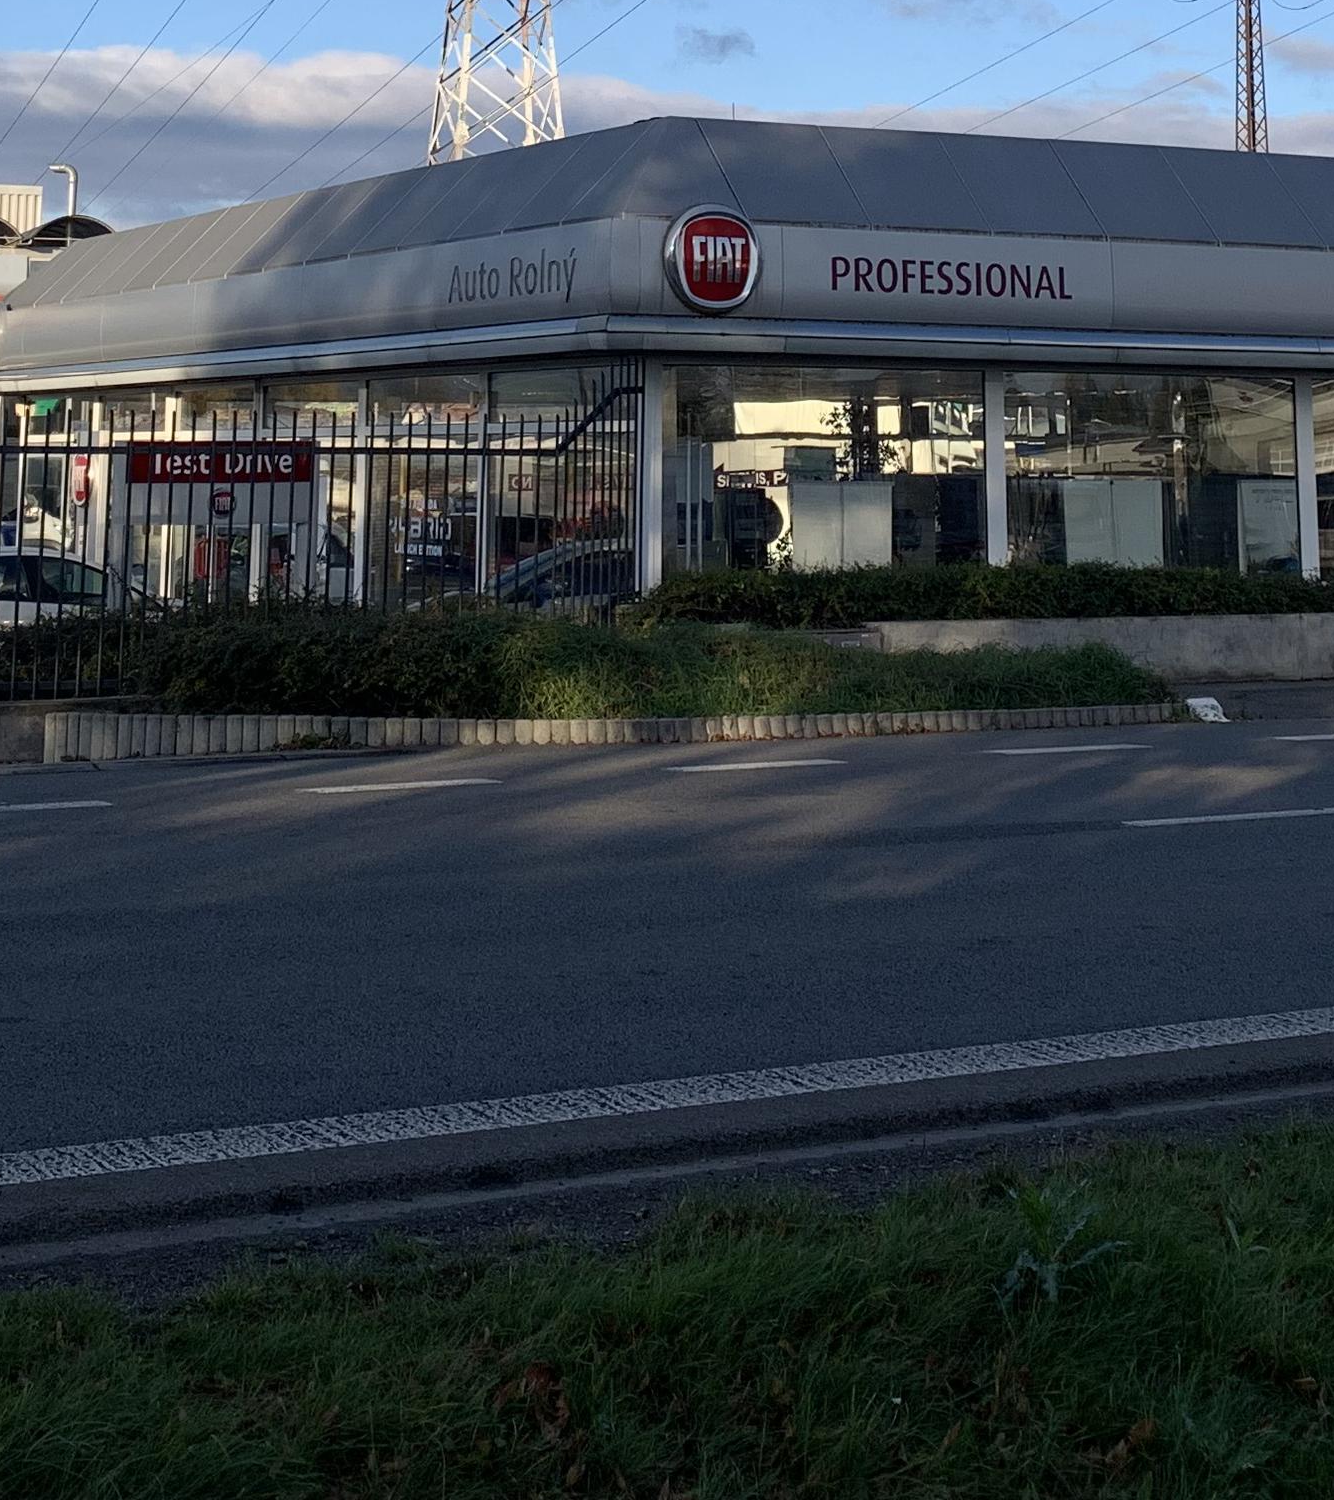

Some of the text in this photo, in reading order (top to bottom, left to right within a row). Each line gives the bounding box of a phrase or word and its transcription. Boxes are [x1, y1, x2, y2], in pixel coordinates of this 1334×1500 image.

[448, 247, 577, 303] Auto Rolný
[692, 235, 747, 283] FIAT
[831, 256, 1073, 300] PROFESSIONAL
[225, 453, 293, 474] Drive
